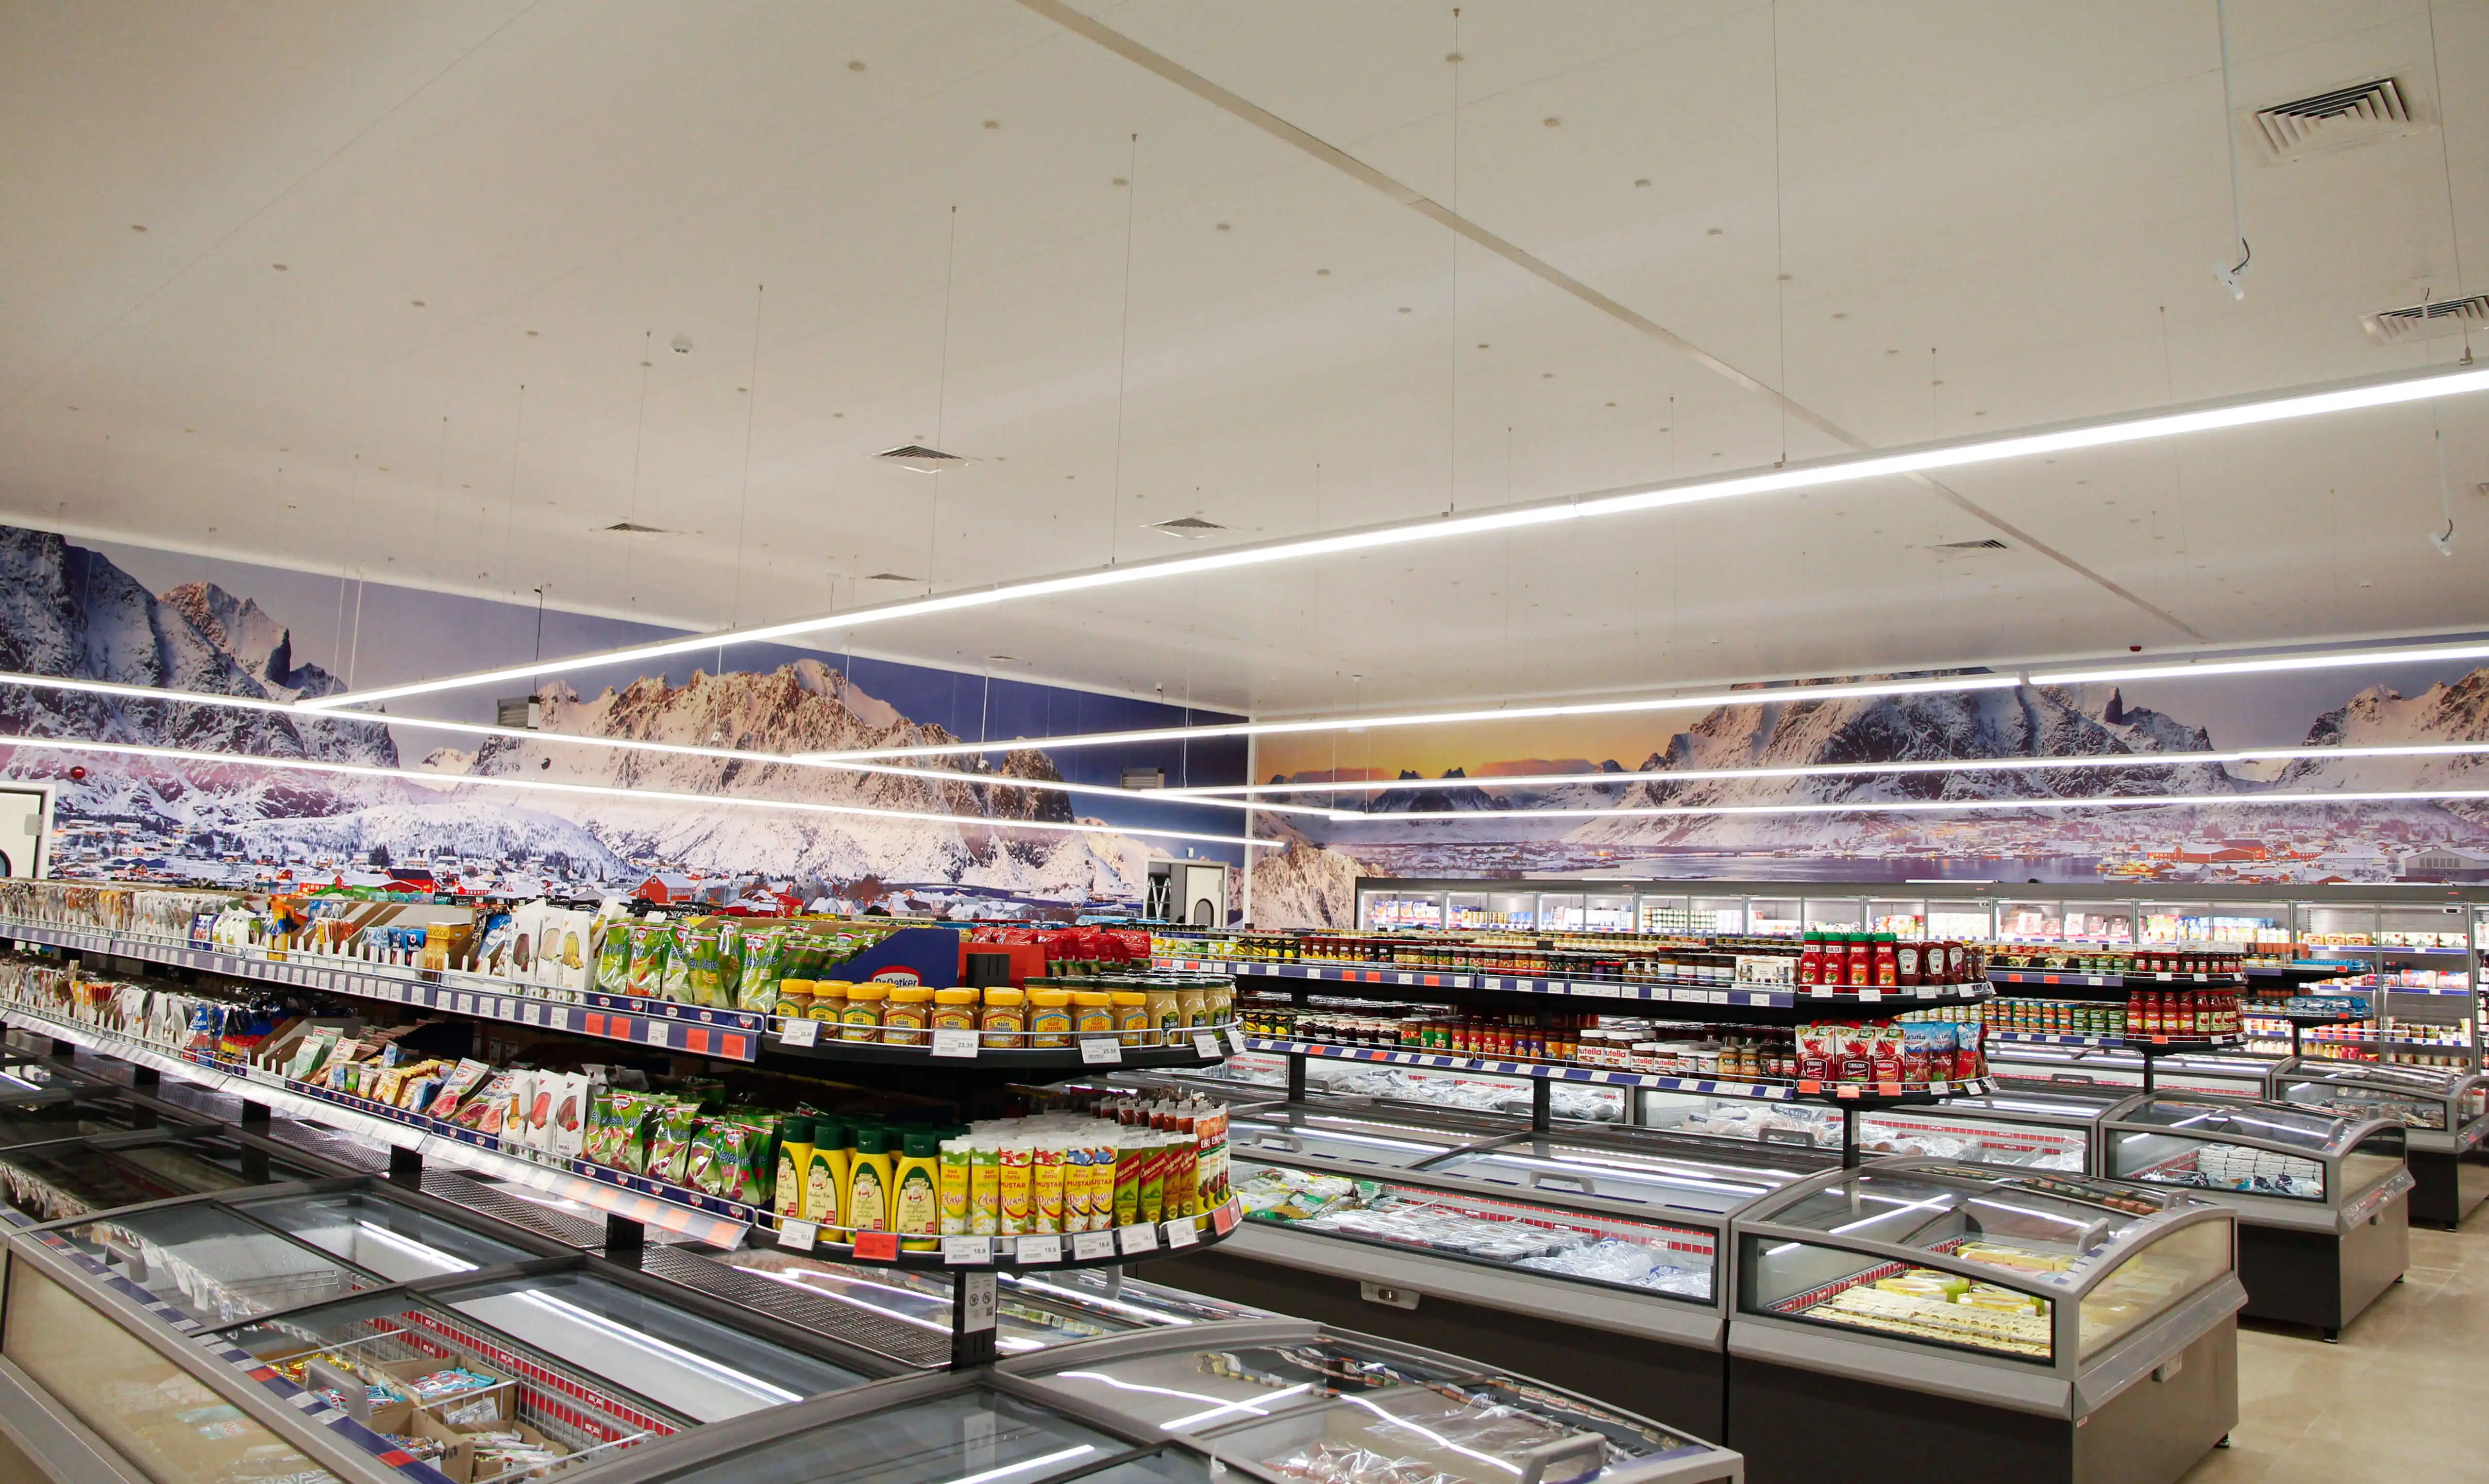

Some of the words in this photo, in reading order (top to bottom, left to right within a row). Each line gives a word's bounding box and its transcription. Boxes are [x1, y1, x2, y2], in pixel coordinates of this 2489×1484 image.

[1578, 1048, 1601, 1056] nutella
[1604, 1049, 1626, 1058] nutella
[976, 1192, 998, 1208] Clas
[1001, 1192, 1026, 1208] Picant
[1036, 1192, 1062, 1207] Picant
